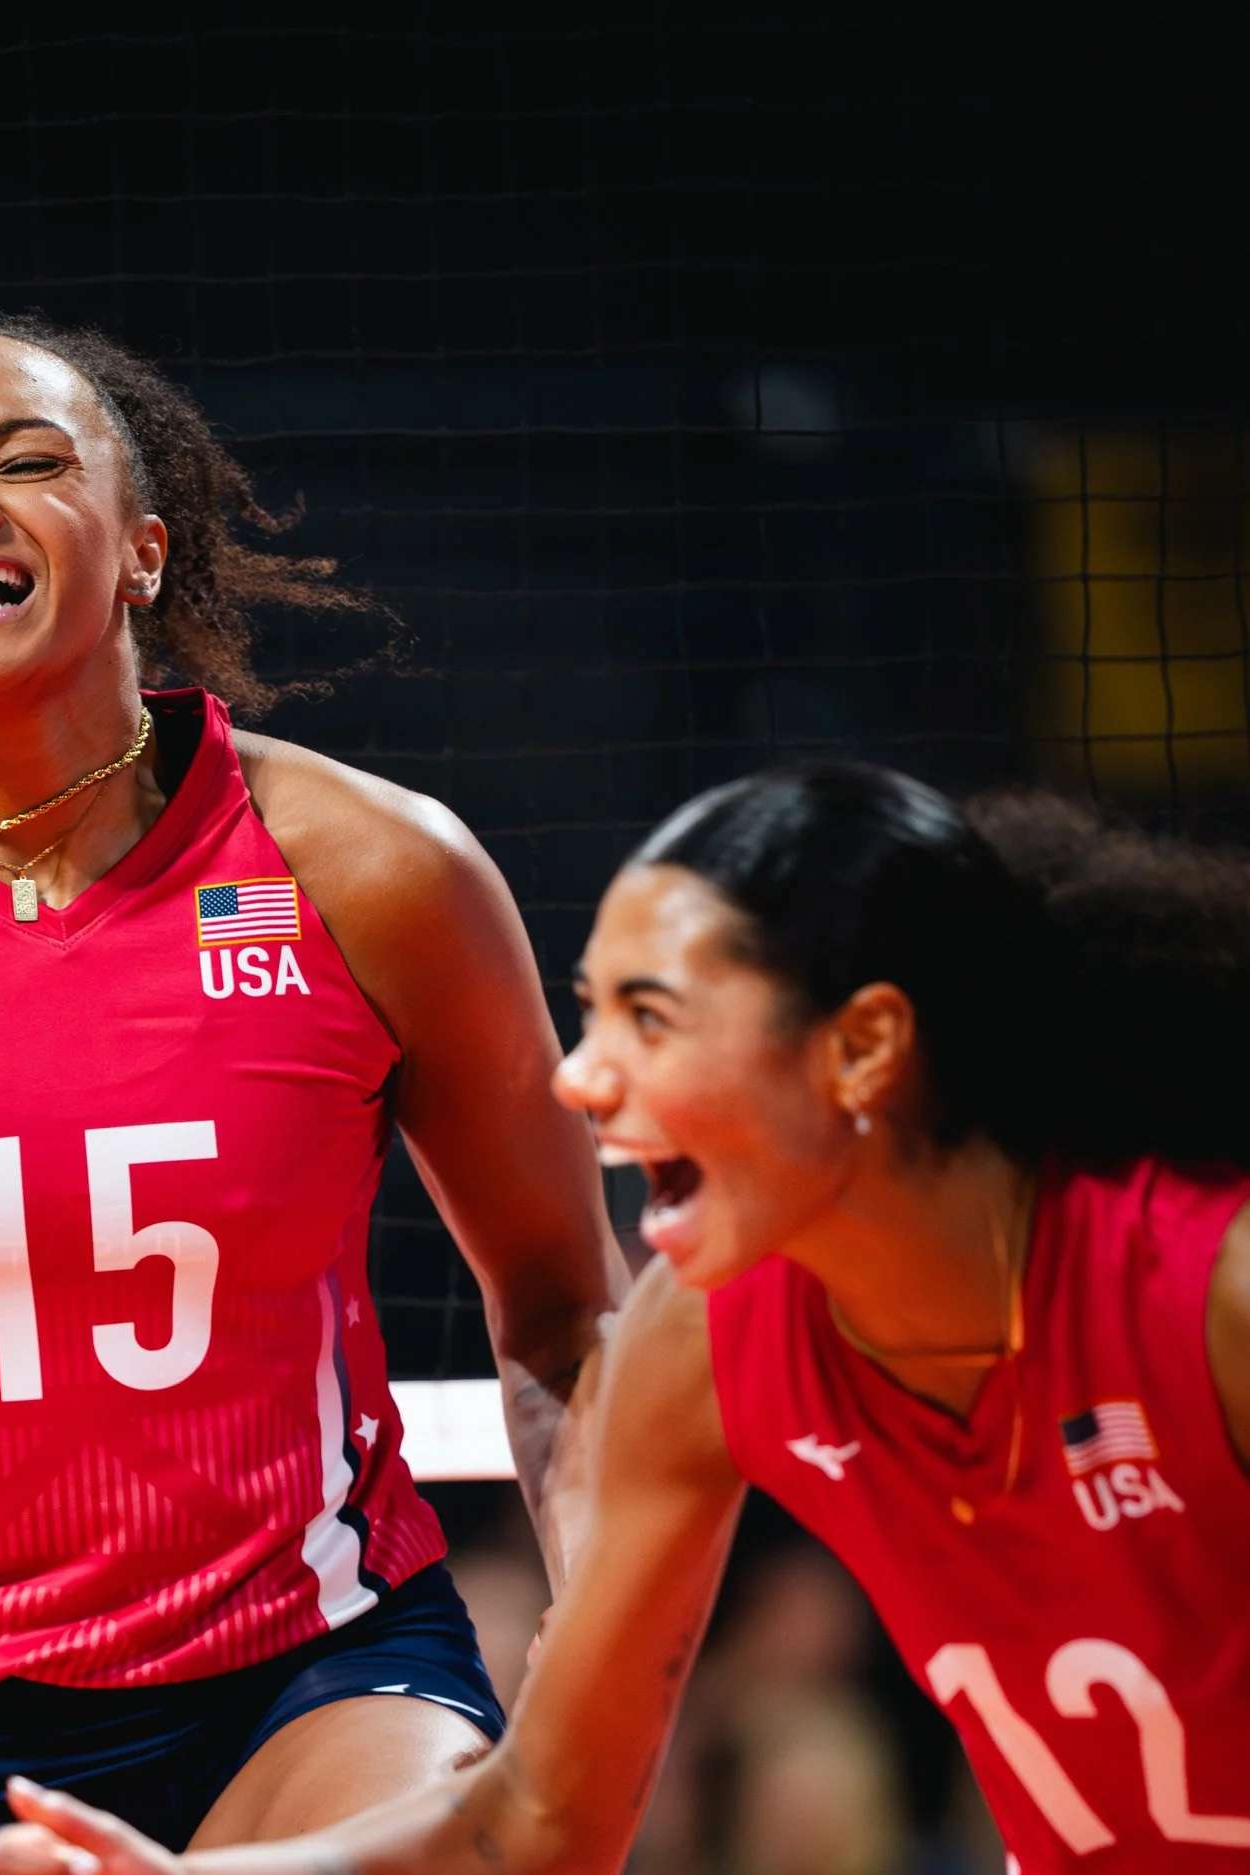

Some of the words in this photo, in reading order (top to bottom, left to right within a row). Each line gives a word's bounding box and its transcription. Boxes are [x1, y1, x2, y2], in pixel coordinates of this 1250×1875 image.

[198, 945, 311, 1000] USA
[1072, 1461, 1185, 1531] USA
[925, 1637, 1250, 1855] 12
